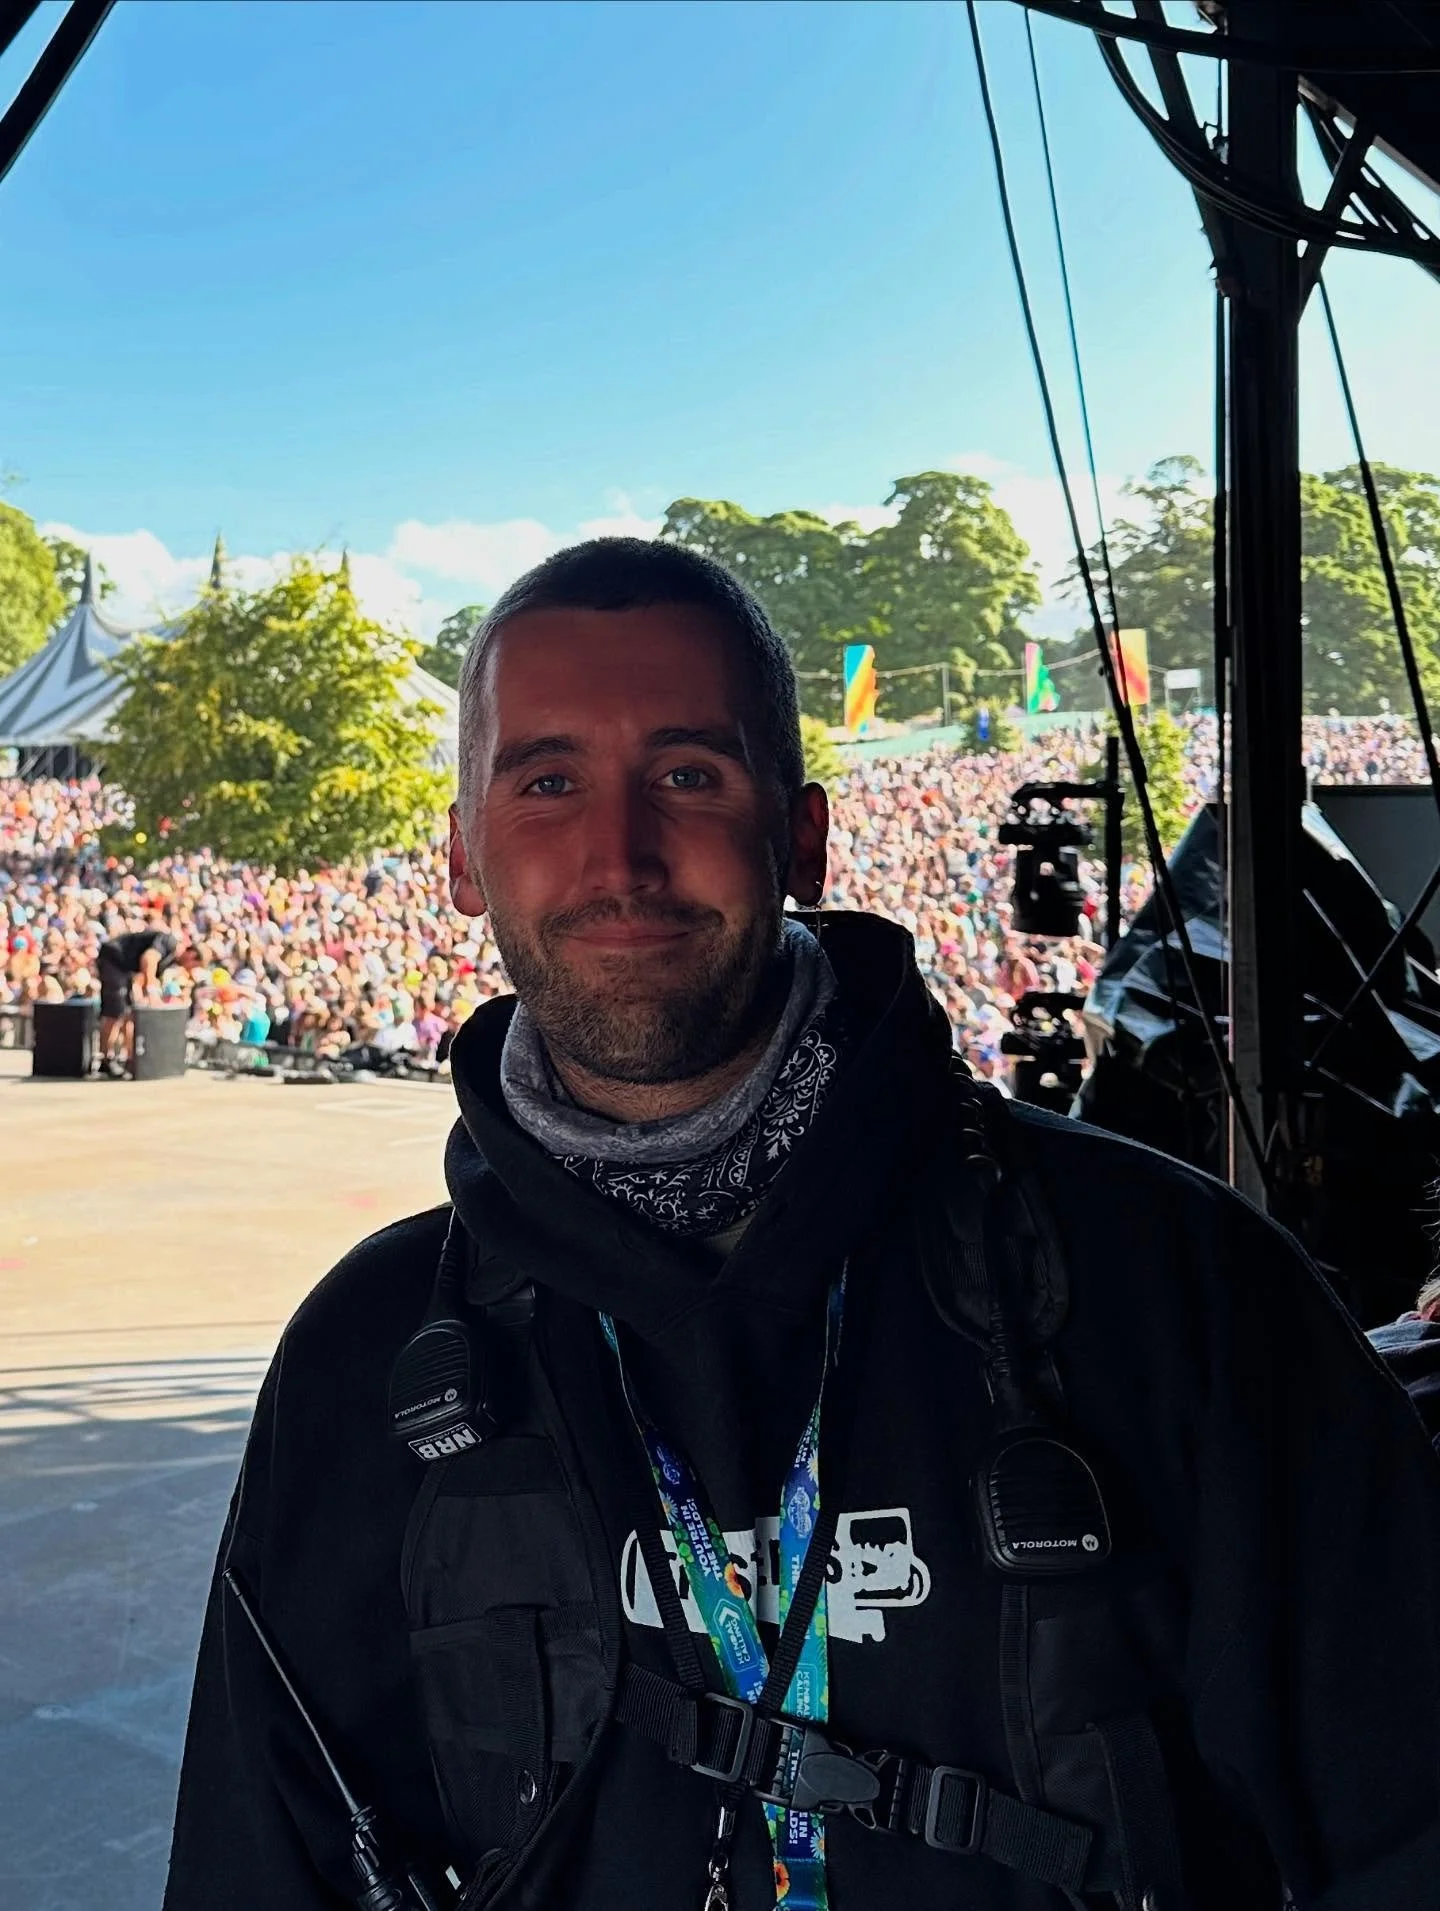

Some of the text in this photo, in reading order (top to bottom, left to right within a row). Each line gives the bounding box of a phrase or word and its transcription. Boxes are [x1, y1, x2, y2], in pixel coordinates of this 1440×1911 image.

[394, 1396, 442, 1419] MOTOROLA
[418, 1428, 477, 1459] NRB
[680, 1505, 712, 1577] YOU'RE IN
[686, 1497, 723, 1581] THE FIELDS!
[1012, 1539, 1078, 1550] MOTOROLA
